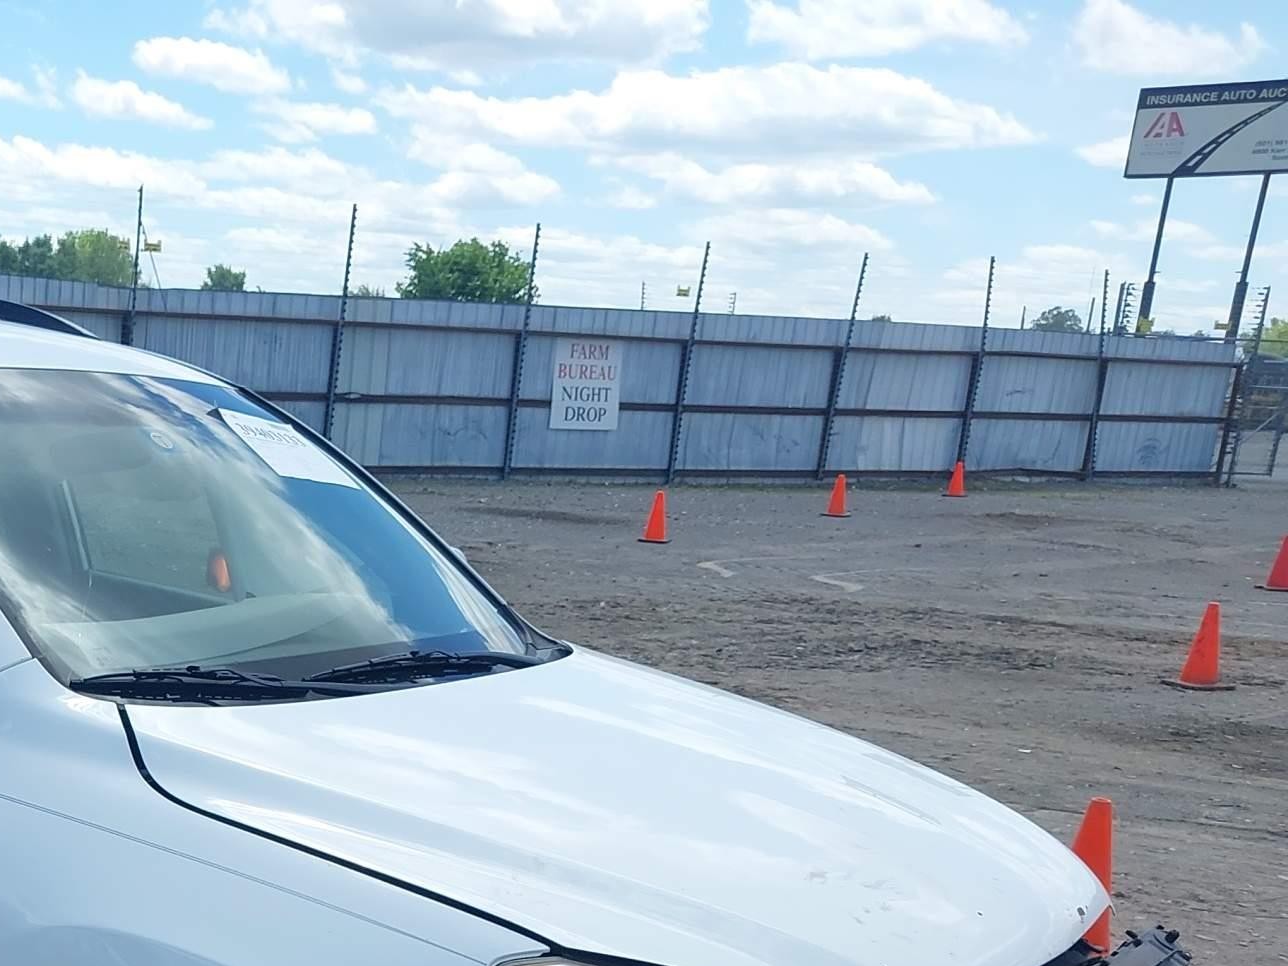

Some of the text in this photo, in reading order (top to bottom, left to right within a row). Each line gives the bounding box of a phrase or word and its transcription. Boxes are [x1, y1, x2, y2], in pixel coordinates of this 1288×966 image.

[1146, 88, 1288, 105] INSURANCE AUTO AUC
[570, 343, 610, 360] FARM
[558, 362, 617, 381] BUREAU
[561, 386, 612, 402] NIGHT
[564, 406, 607, 422] DROP
